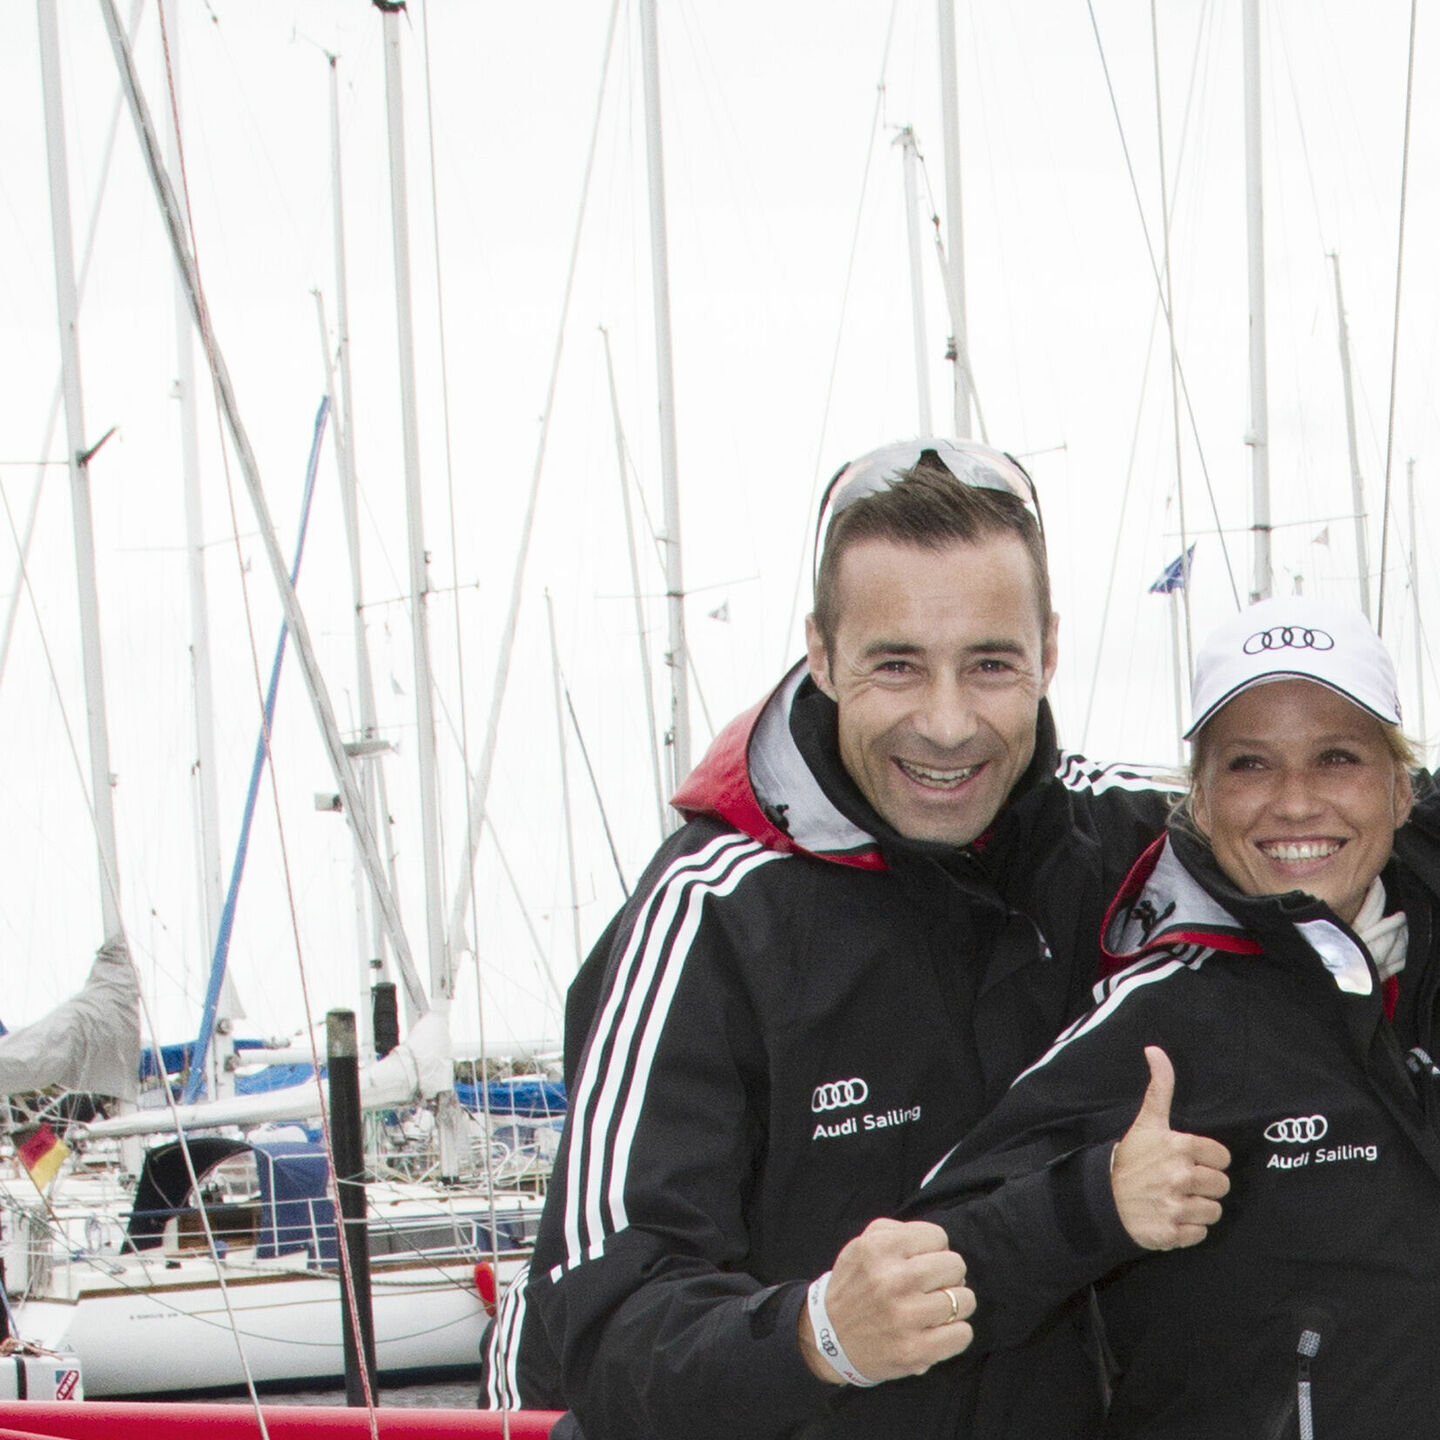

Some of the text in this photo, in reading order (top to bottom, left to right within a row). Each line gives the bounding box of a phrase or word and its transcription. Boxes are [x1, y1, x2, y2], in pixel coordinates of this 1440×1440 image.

[812, 1106, 921, 1140] Audi Sailing
[1266, 1144, 1378, 1168] Audi Sailing
